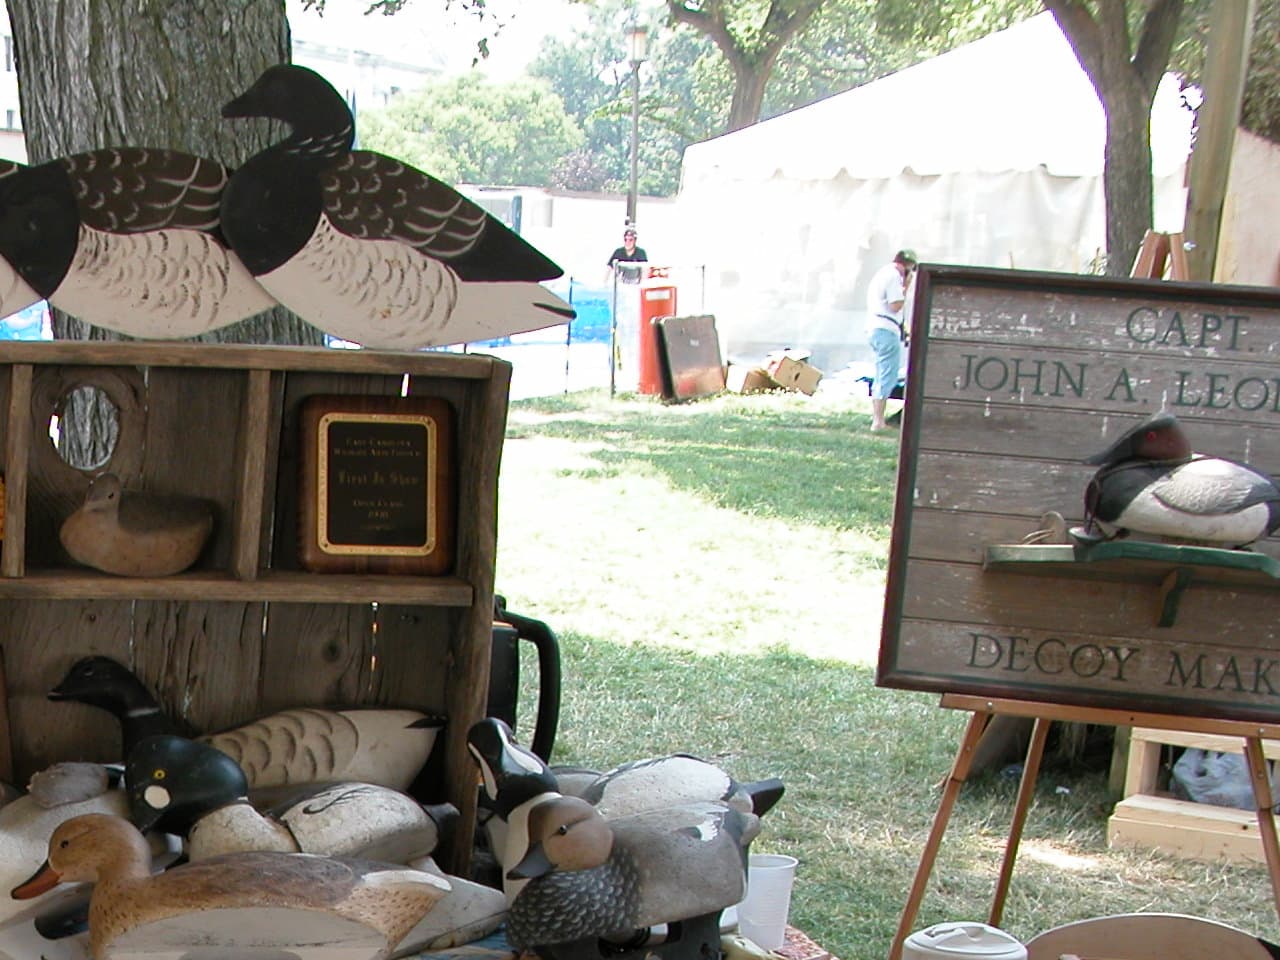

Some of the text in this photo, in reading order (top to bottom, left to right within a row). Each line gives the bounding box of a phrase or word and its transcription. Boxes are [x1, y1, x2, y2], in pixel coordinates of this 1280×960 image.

[1126, 306, 1255, 352] CAPT.
[955, 354, 1088, 398] JOHN
[1104, 368, 1148, 404] A.
[969, 632, 1140, 682] DECOY
